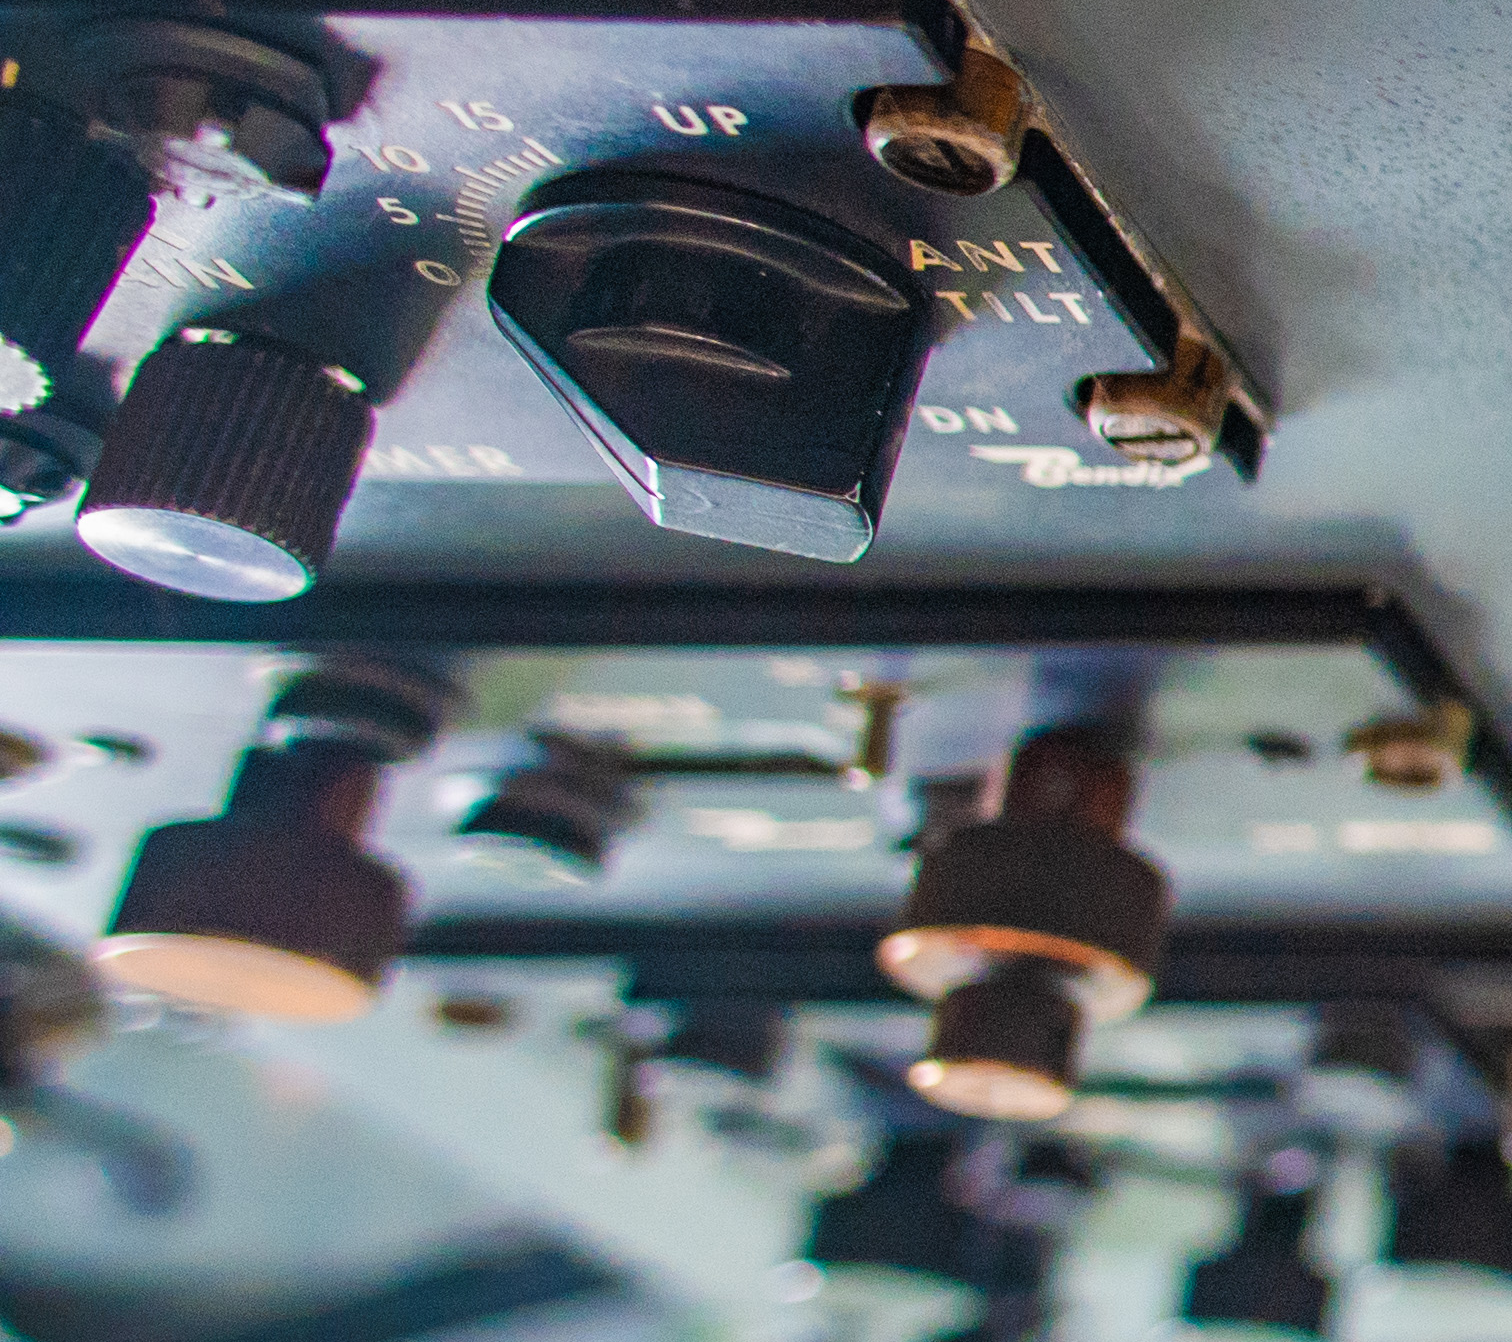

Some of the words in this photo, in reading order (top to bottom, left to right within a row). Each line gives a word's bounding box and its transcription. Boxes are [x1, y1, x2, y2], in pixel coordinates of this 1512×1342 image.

[434, 101, 515, 132] 15
[652, 105, 750, 137] UP
[376, 196, 420, 226] 5
[908, 239, 1063, 274] ANT
[934, 290, 1092, 325] TILT
[918, 405, 1020, 435] DN
